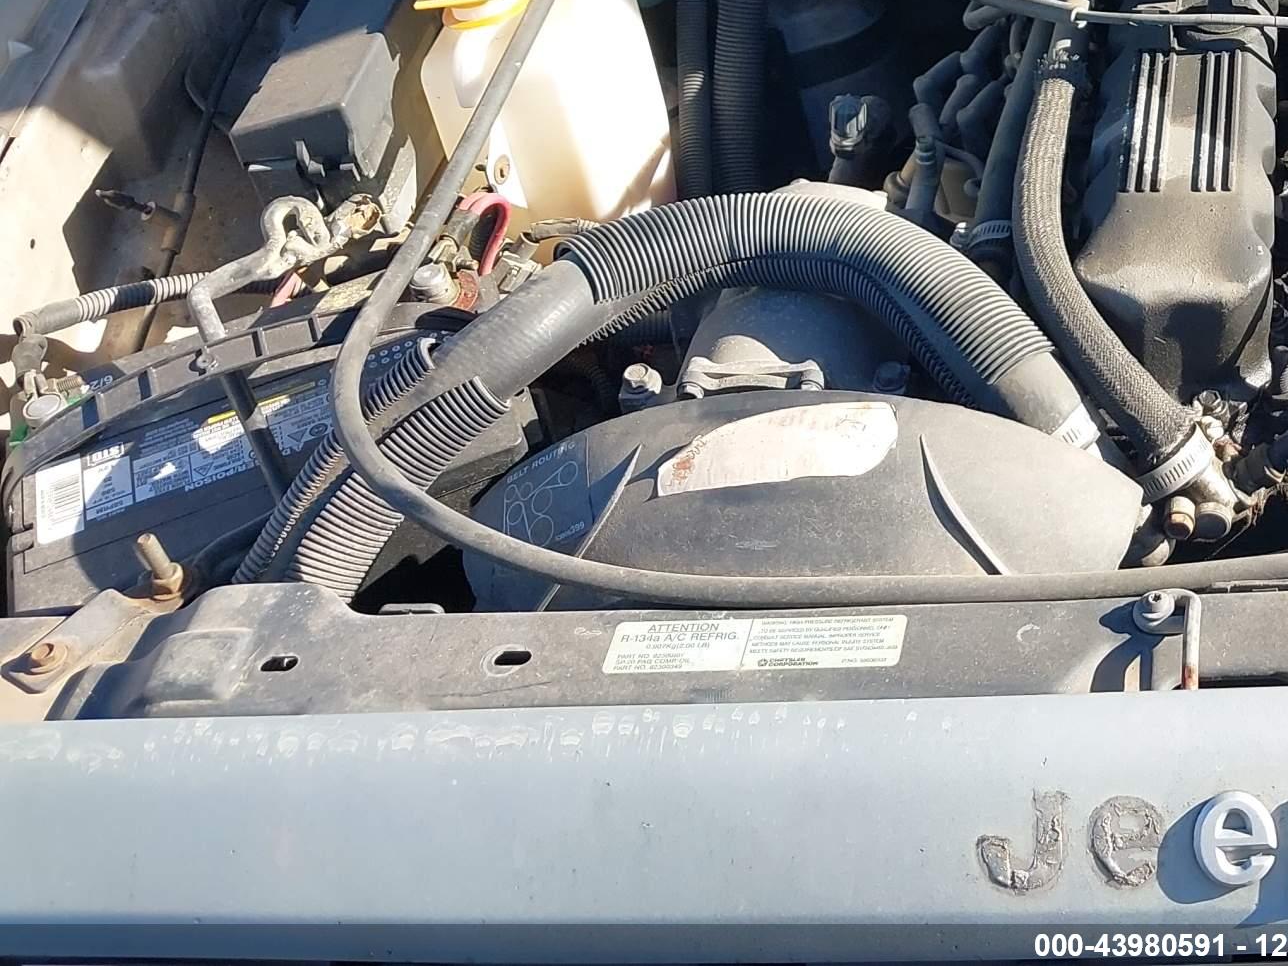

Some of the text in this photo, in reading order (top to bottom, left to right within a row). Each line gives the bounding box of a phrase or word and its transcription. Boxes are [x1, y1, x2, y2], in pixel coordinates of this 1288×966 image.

[506, 440, 577, 484] BELT ROUTING
[648, 623, 720, 633] ATTENTION
[620, 634, 660, 643] R-134a
[664, 633, 687, 642] A/C
